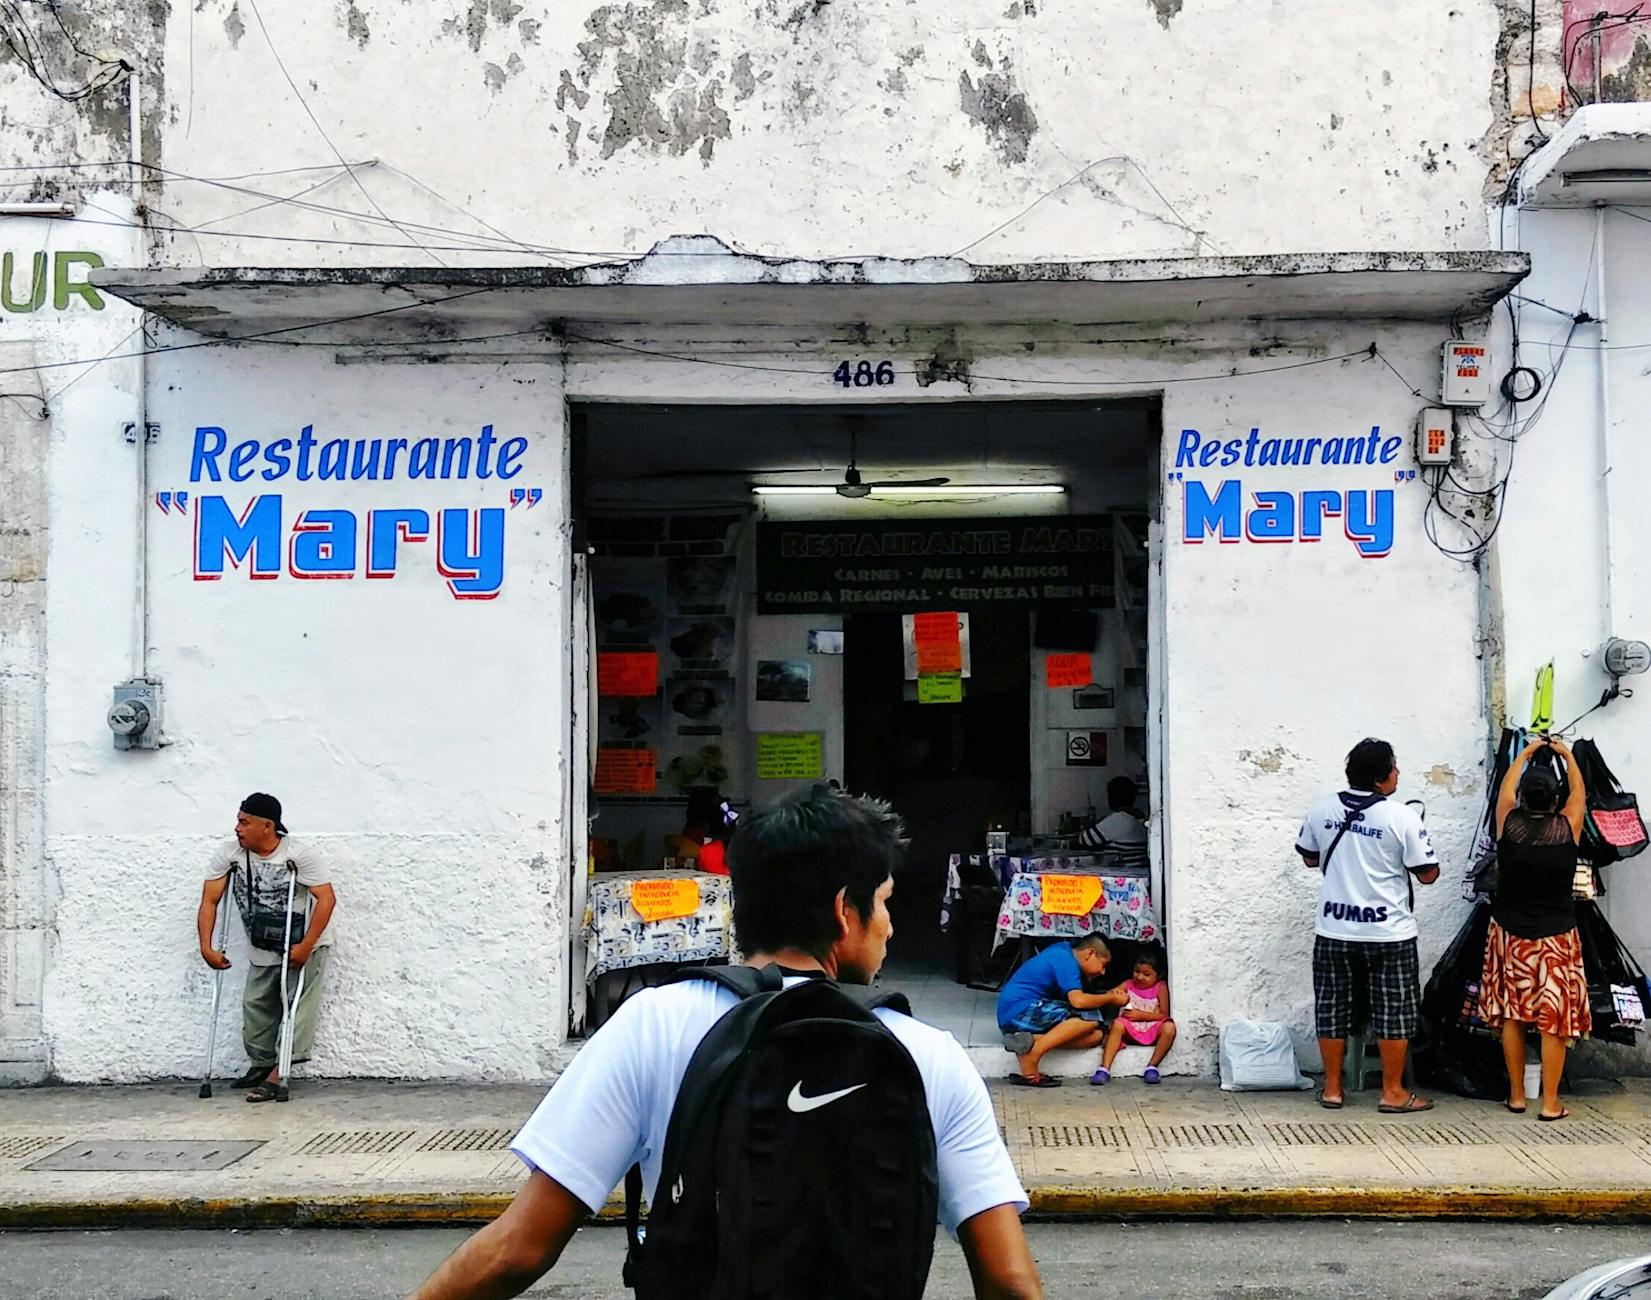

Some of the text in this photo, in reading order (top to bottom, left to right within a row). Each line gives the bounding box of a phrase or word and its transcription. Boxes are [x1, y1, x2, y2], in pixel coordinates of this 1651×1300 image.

[833, 359, 895, 389] 486
[189, 424, 528, 483] Restaurante
[1175, 426, 1402, 468] Restaurante
[780, 531, 1012, 558] RESTAURANTE
[834, 565, 1069, 581] CARNES AVES MARISCOS
[764, 589, 833, 604] COMIDA
[839, 587, 931, 602] REGIONAL
[949, 585, 1038, 600] CERVEZAS
[1323, 901, 1388, 922] PUMAS
